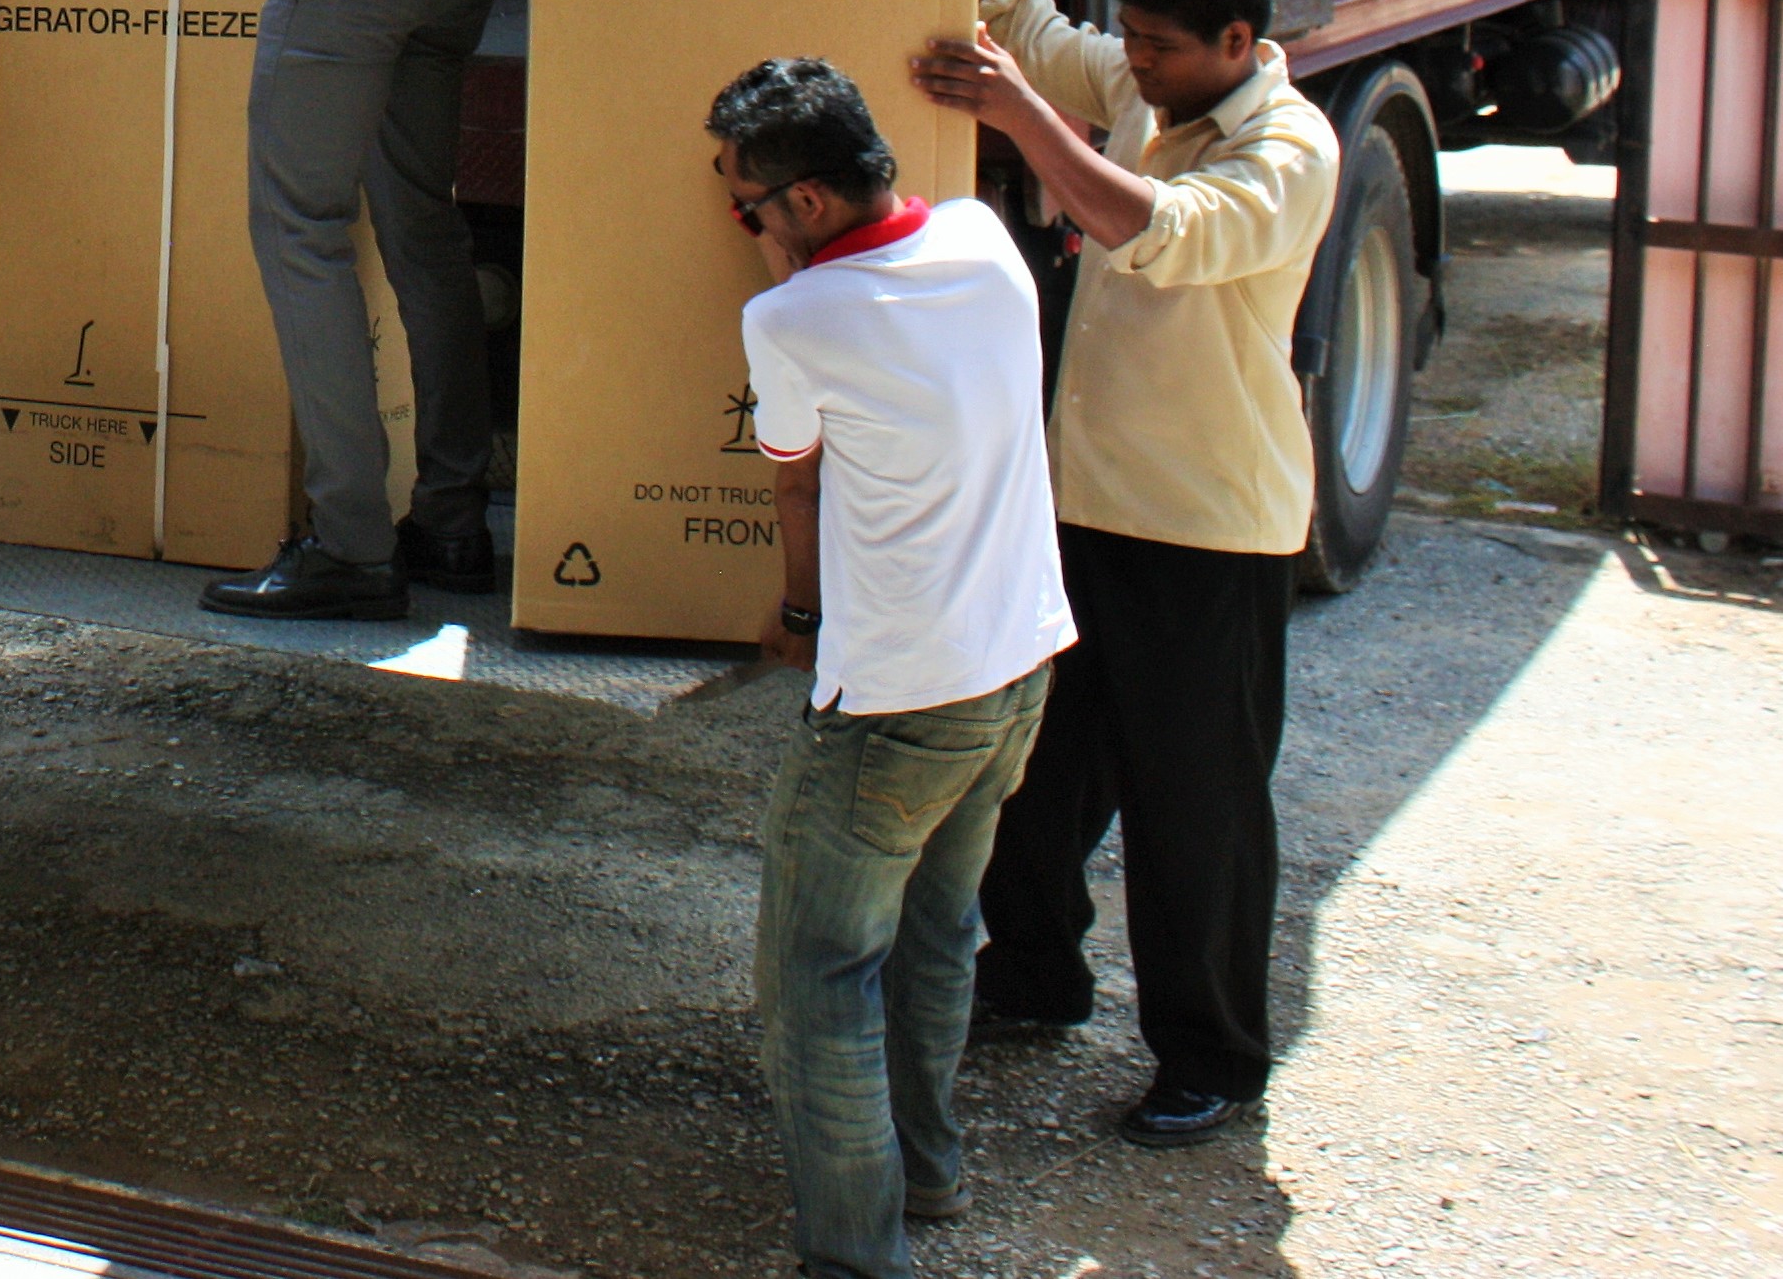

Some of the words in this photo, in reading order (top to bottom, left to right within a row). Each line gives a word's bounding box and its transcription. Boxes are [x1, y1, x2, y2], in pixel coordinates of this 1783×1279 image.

[29, 411, 82, 432] TRUCK
[87, 420, 128, 435] HERE
[49, 440, 106, 469] SIDE
[634, 484, 663, 501] DO
[670, 485, 711, 502] NOT
[718, 487, 774, 505] TRUC
[685, 517, 780, 546] FRON
